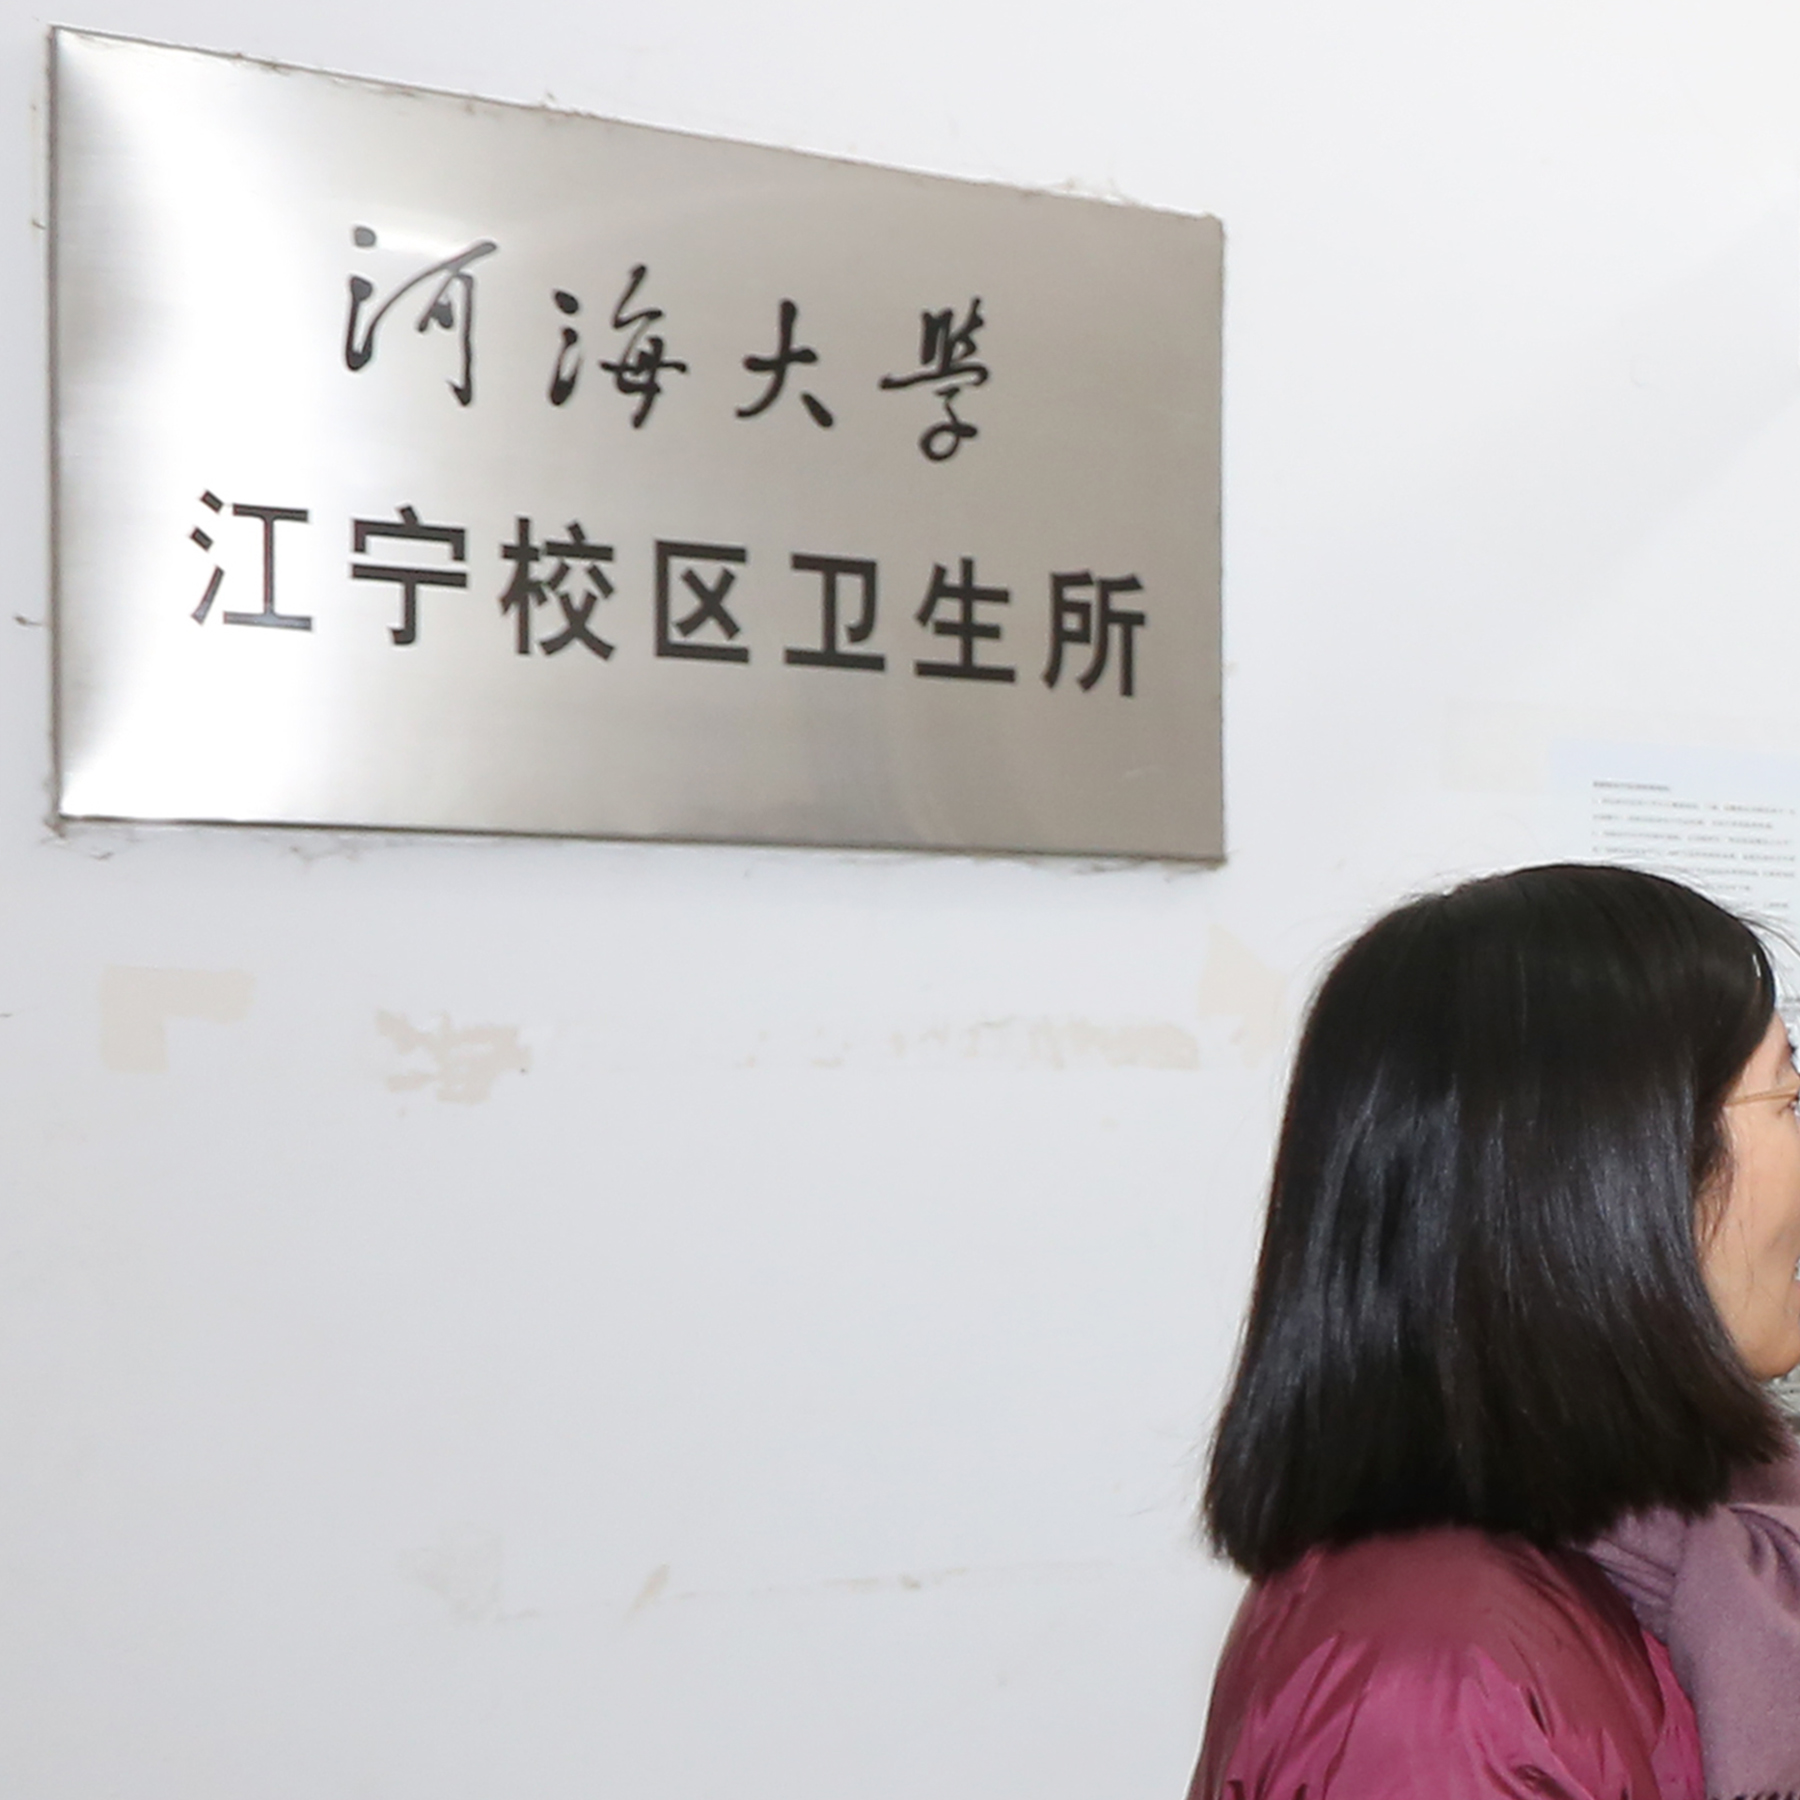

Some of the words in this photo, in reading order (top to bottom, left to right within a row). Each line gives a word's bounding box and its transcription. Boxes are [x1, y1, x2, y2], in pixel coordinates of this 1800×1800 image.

[189, 490, 1147, 698] 江宁校区卫生所
